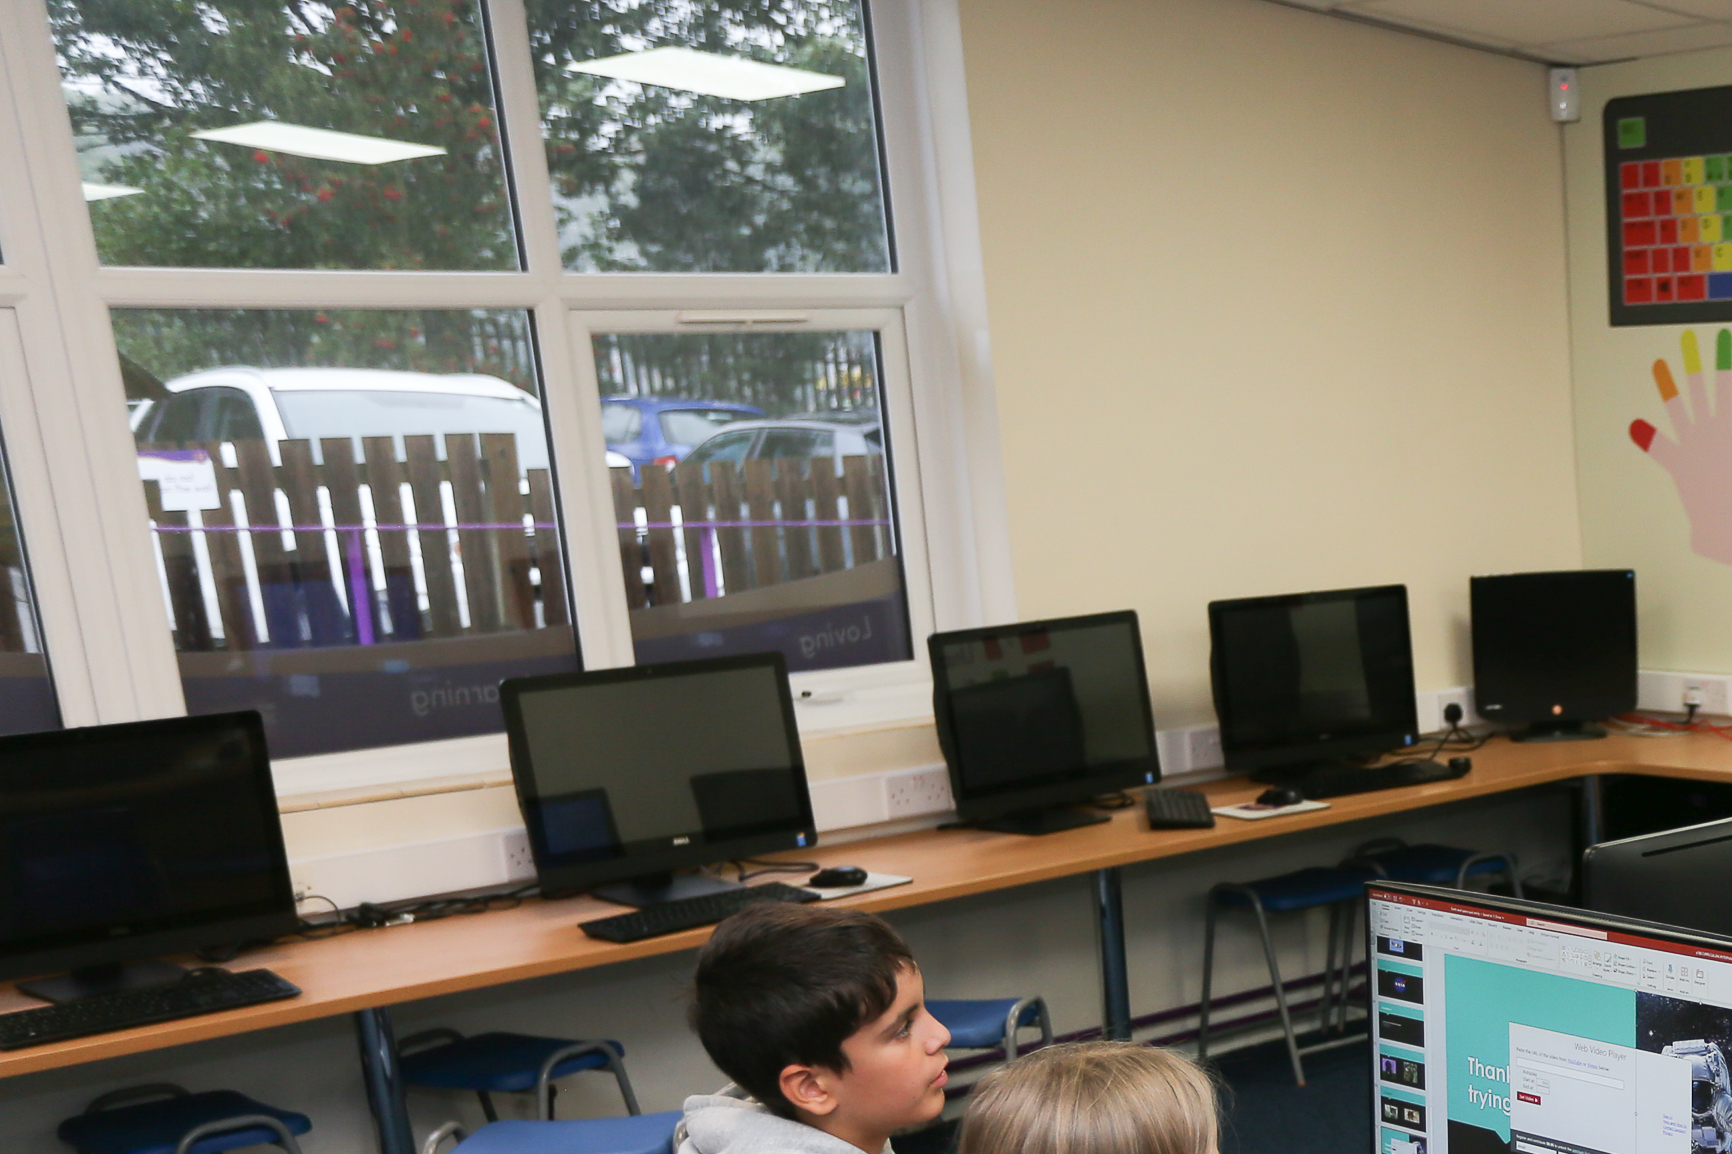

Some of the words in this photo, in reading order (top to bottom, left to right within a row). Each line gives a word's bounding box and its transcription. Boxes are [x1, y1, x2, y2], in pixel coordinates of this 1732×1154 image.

[1574, 1042, 1589, 1053] Web
[1589, 1045, 1608, 1057] Video
[1608, 1049, 1628, 1061] Player
[1468, 1084, 1510, 1117] trying
